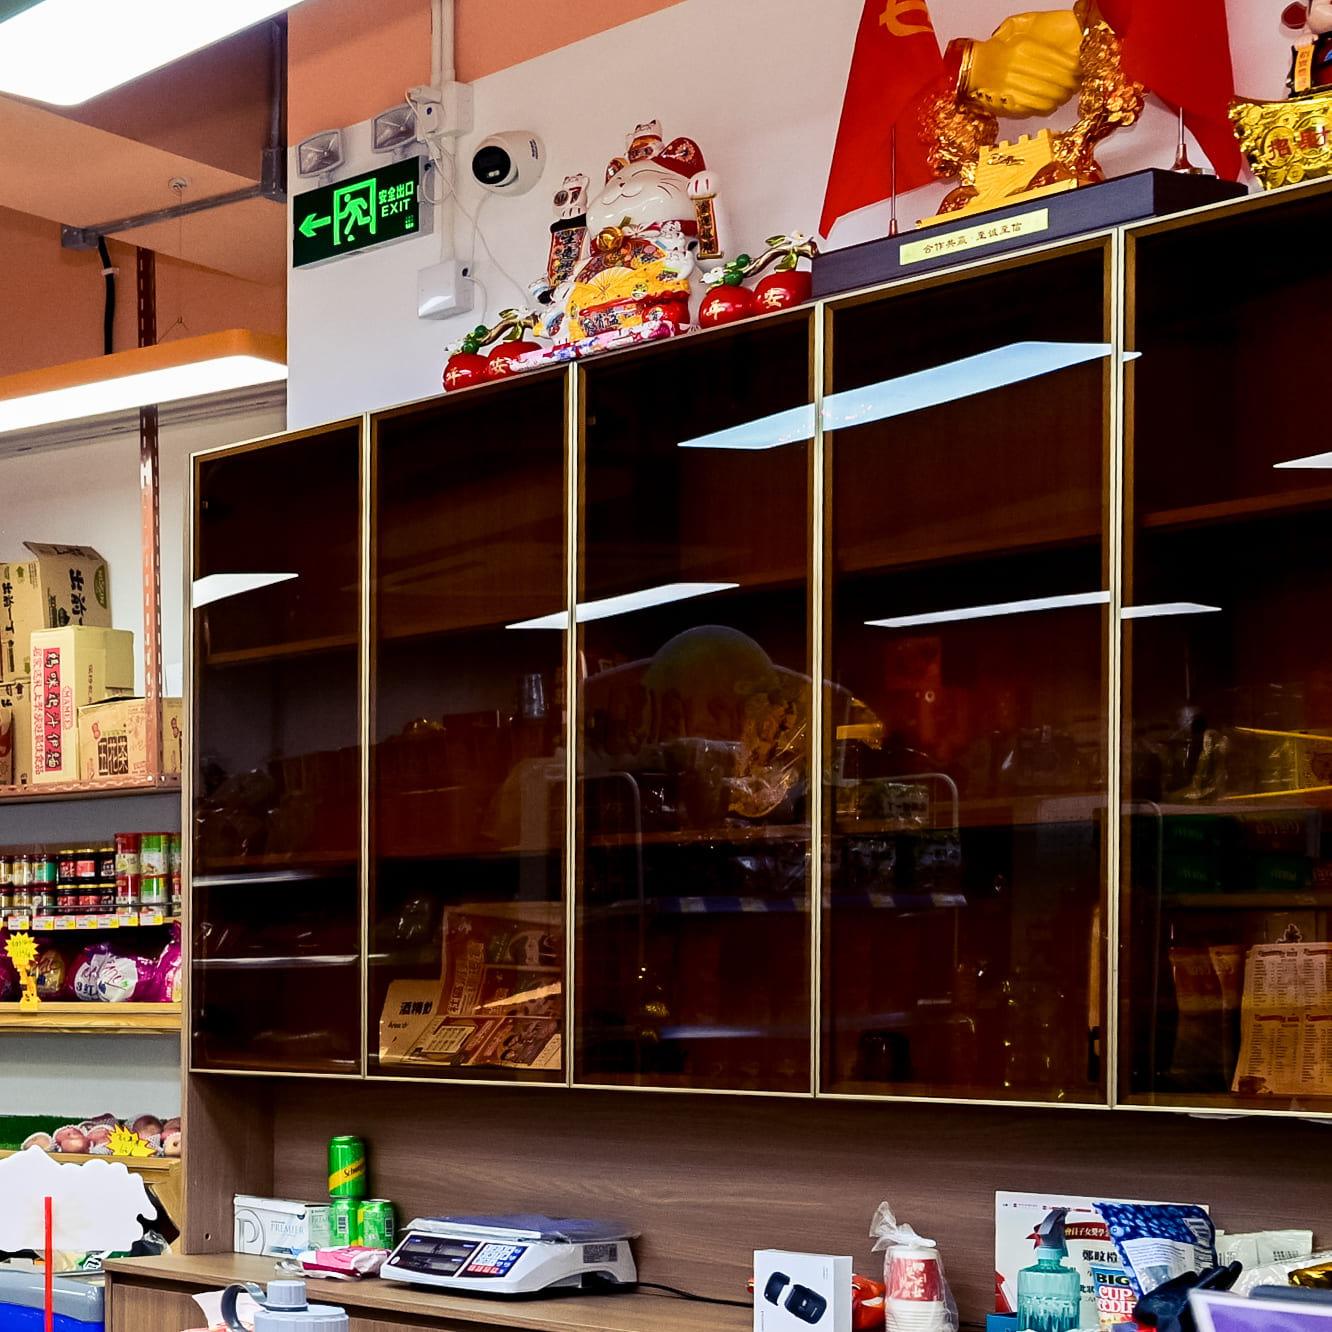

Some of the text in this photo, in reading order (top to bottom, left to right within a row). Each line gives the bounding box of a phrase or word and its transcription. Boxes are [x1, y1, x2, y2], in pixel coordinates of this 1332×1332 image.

[378, 181, 414, 204] 安全出口
[381, 199, 410, 218] EXIT
[762, 290, 784, 309] 安
[98, 736, 129, 776] 五花茶
[1096, 1273, 1130, 1285] BIG
[1099, 1287, 1132, 1300] CUP
